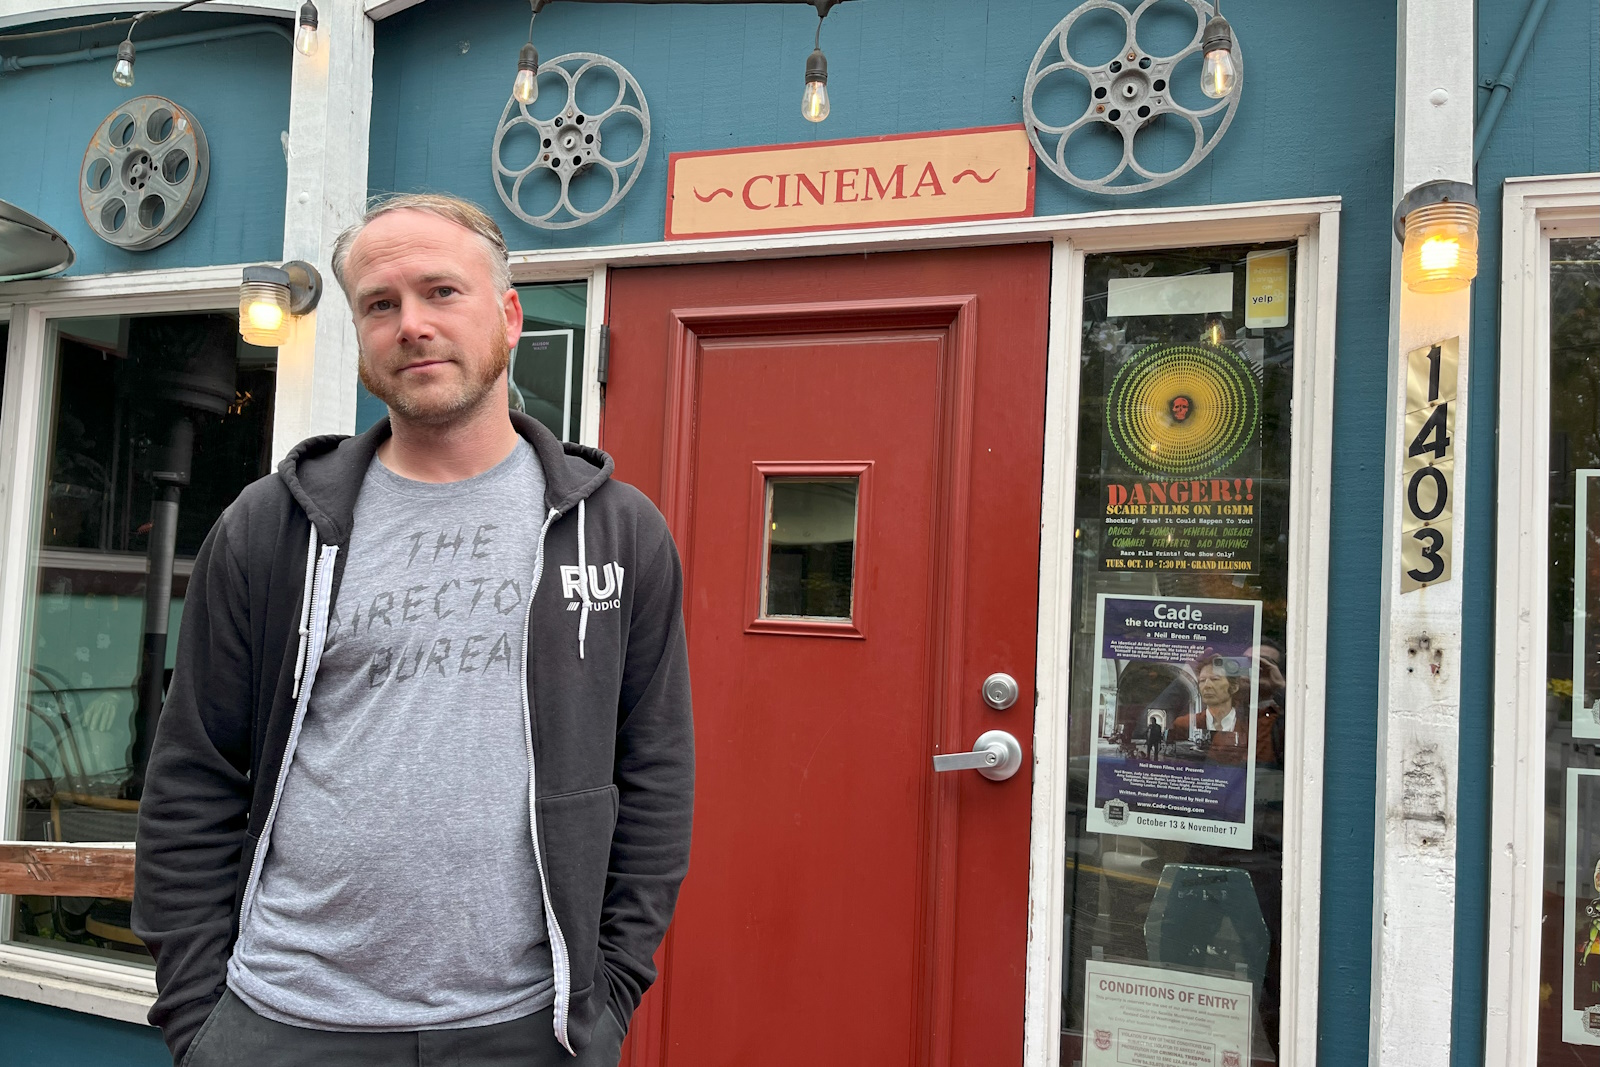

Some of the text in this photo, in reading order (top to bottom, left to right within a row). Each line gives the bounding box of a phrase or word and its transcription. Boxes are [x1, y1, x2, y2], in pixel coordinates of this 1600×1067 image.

[742, 161, 946, 210] CINEMA
[1252, 295, 1273, 305] yelp
[1406, 345, 1450, 583] 1403
[1107, 478, 1253, 505] DANGER!!
[1106, 505, 1253, 515] SCARE FILMS ON 16MM
[1108, 526, 1254, 537] DRUGS! A-BOMBS! VENEREAL DISEASE!
[402, 524, 499, 568] THE
[1112, 538, 1249, 549] COMMIES! PERVERTS! BAD DRIVING!
[1106, 559, 1126, 568] TUES.
[1127, 559, 1143, 568] OCT.
[1145, 560, 1154, 568] 10
[1159, 560, 1174, 568] 7:30
[1175, 561, 1186, 569] PM
[1191, 561, 1216, 569] GRAND
[1218, 561, 1251, 569] ILLUSION
[582, 599, 620, 611] TUDIO
[1153, 604, 1203, 621] Cade
[1125, 617, 1229, 634] the tortured crossing
[1193, 633, 1207, 641] film
[369, 632, 512, 689] BUREA
[1137, 802, 1205, 813] www.Cade-Crossing.com
[1137, 817, 1237, 835] October 13 & November 17
[1099, 979, 1238, 1011] CONDITIONS OF ENTRY
